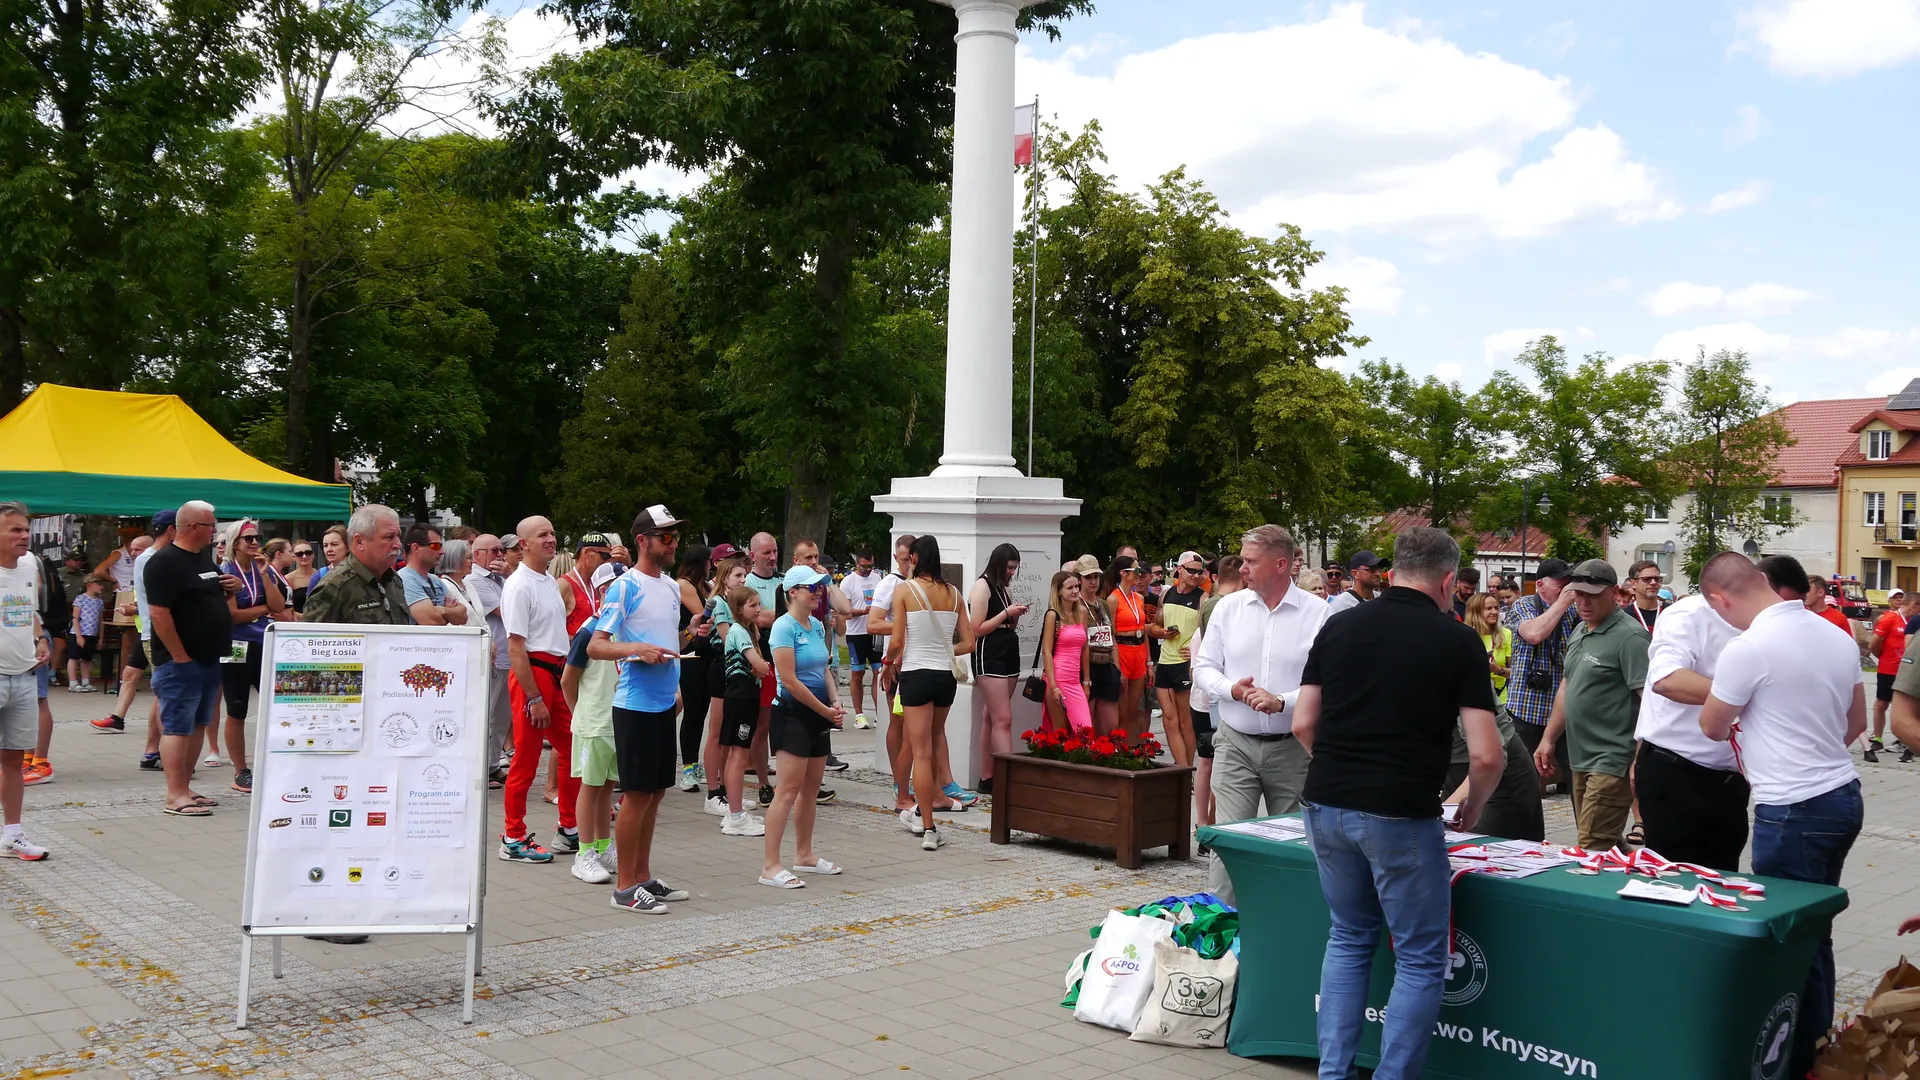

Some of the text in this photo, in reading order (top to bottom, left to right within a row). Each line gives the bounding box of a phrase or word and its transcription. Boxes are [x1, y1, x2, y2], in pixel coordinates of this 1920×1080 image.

[308, 638, 361, 647] Biebrzański
[311, 648, 357, 657] Bieg Łosia
[409, 790, 442, 799] Program
[1180, 998, 1203, 1008] LECIE
[1482, 1026, 1598, 1079] Knyszyn
